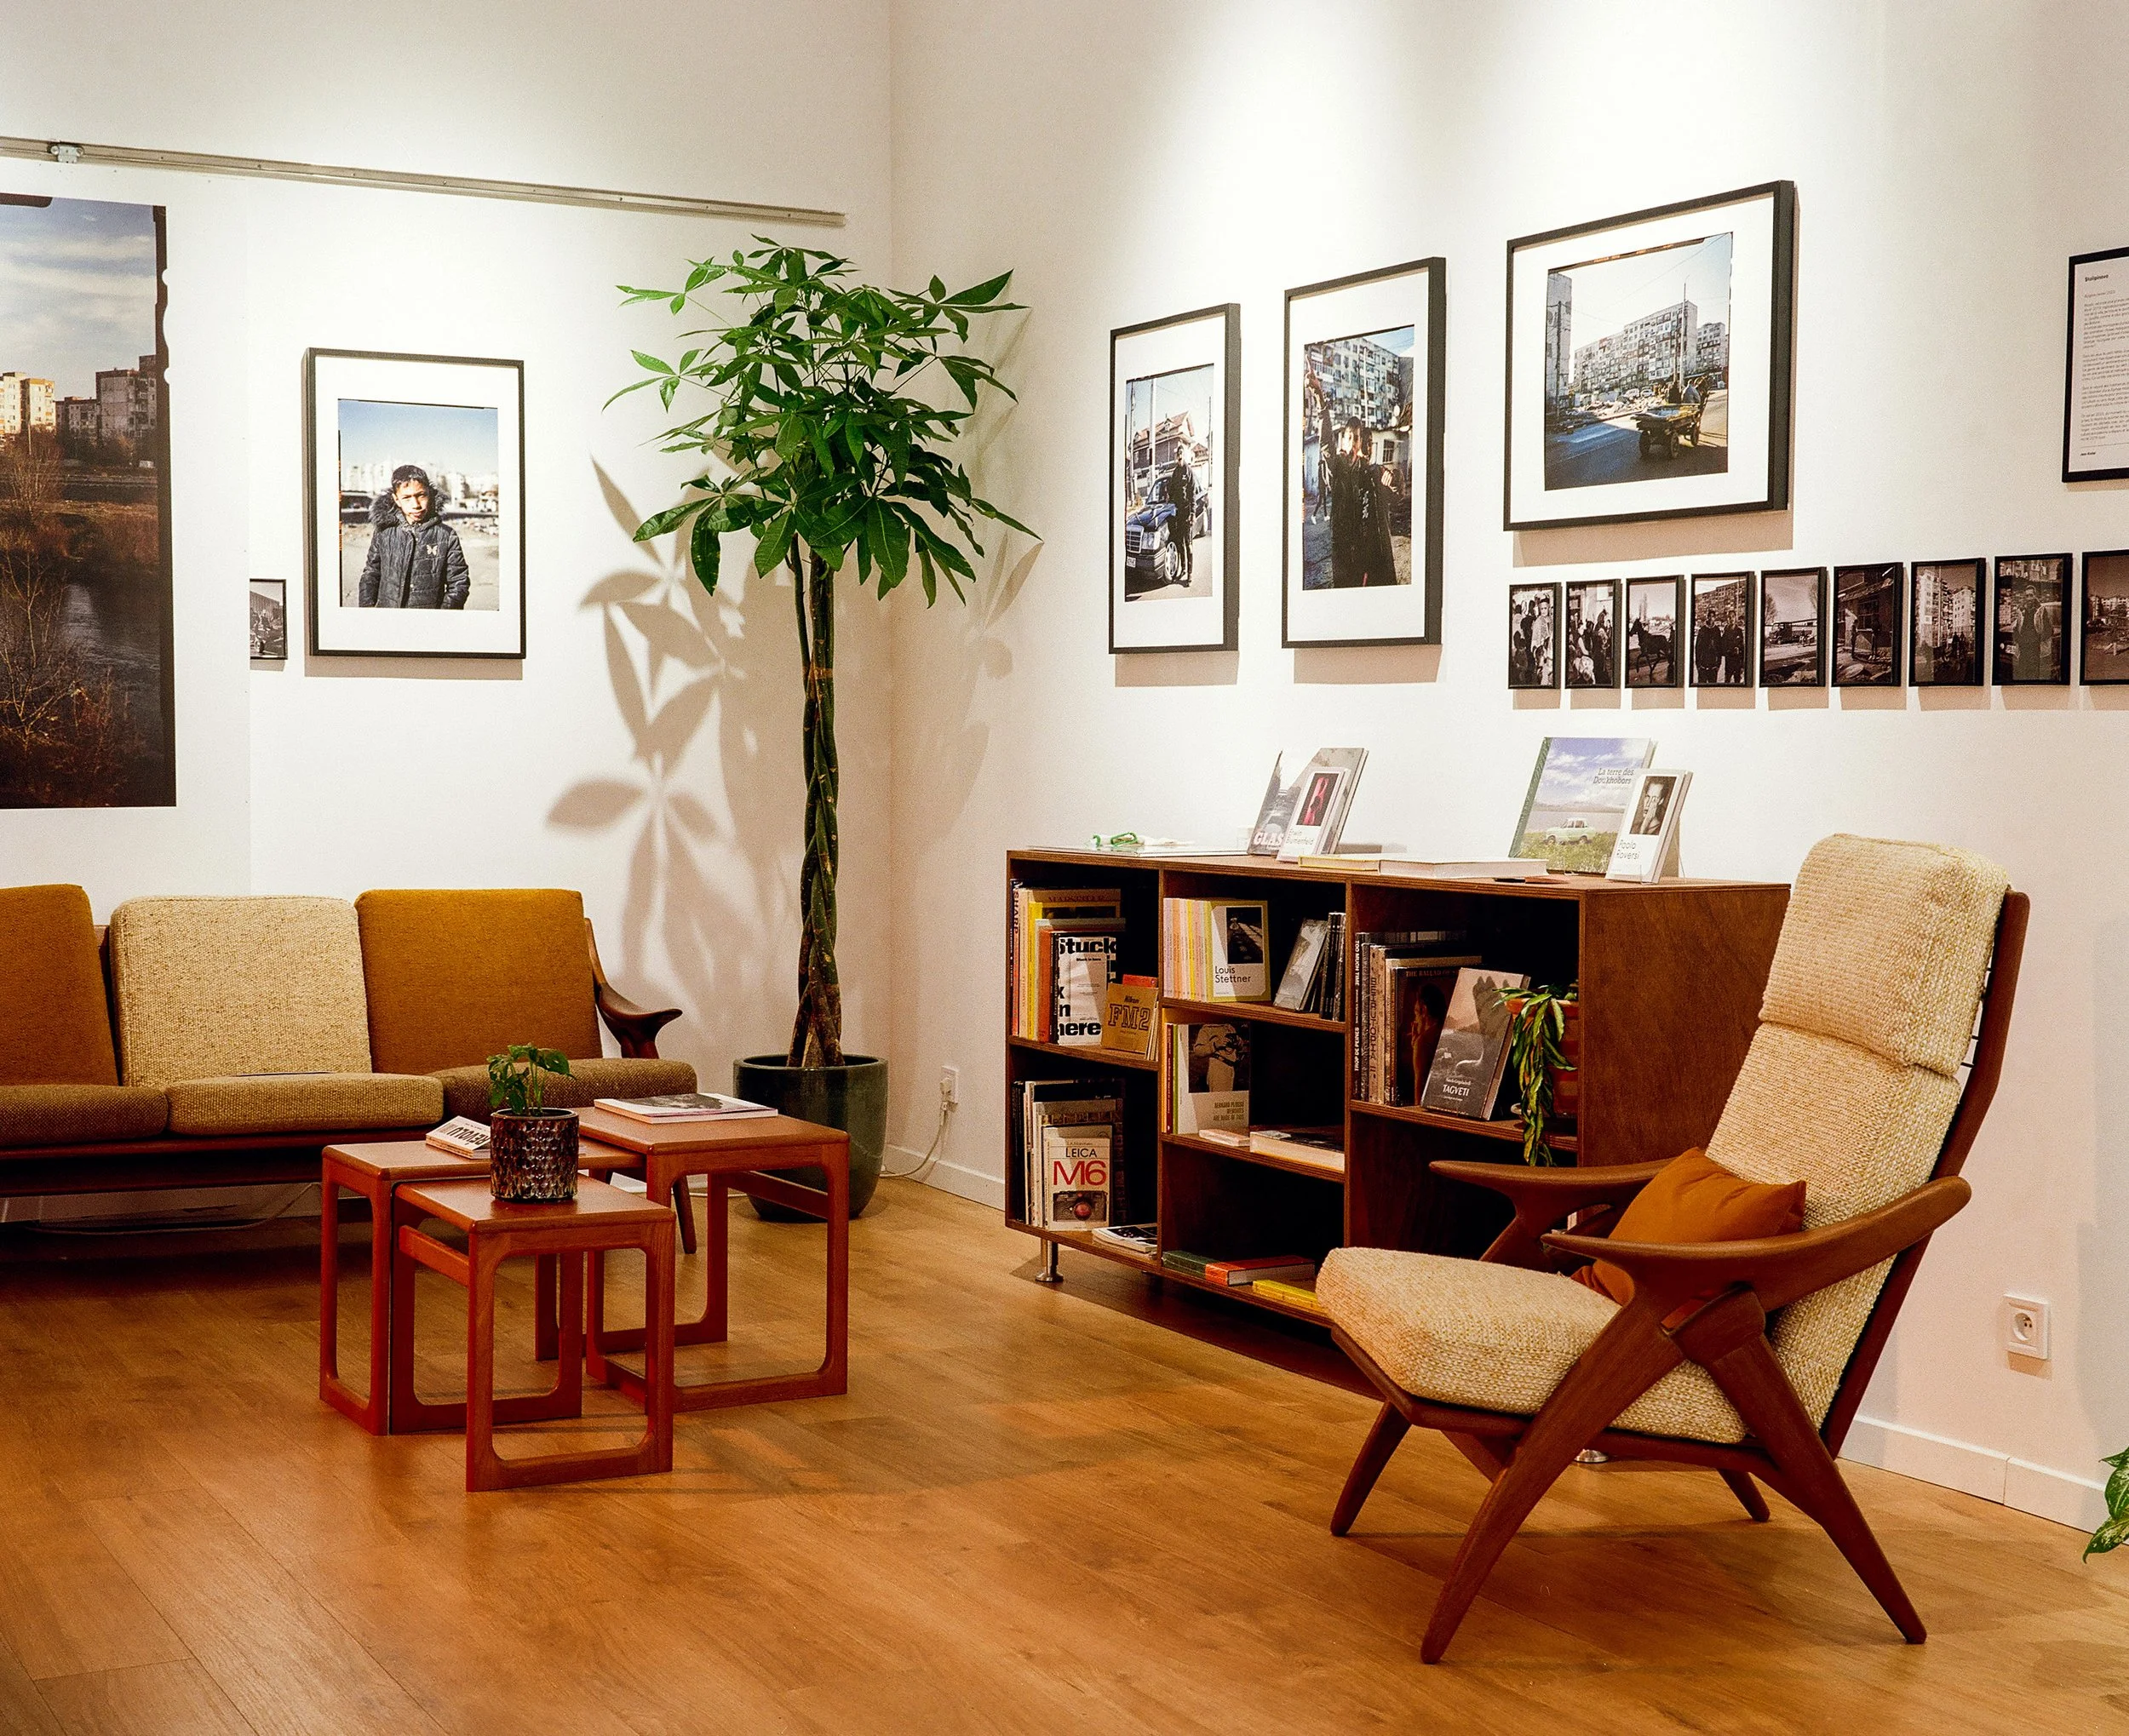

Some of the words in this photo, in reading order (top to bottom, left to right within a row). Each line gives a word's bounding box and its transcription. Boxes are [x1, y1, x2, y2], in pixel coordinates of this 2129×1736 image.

[1598, 767, 1606, 776] La
[1622, 767, 1635, 776] des
[1215, 965, 1236, 974] Louis
[1215, 974, 1251, 983] Stettner
[1124, 994, 1139, 1004] Nikon
[1108, 1003, 1151, 1030] FM2
[1354, 1047, 1359, 1056] DE
[1443, 1084, 1470, 1097] TAGVETI
[1065, 1147, 1099, 1158] LEICA
[1053, 1160, 1108, 1186] M6
